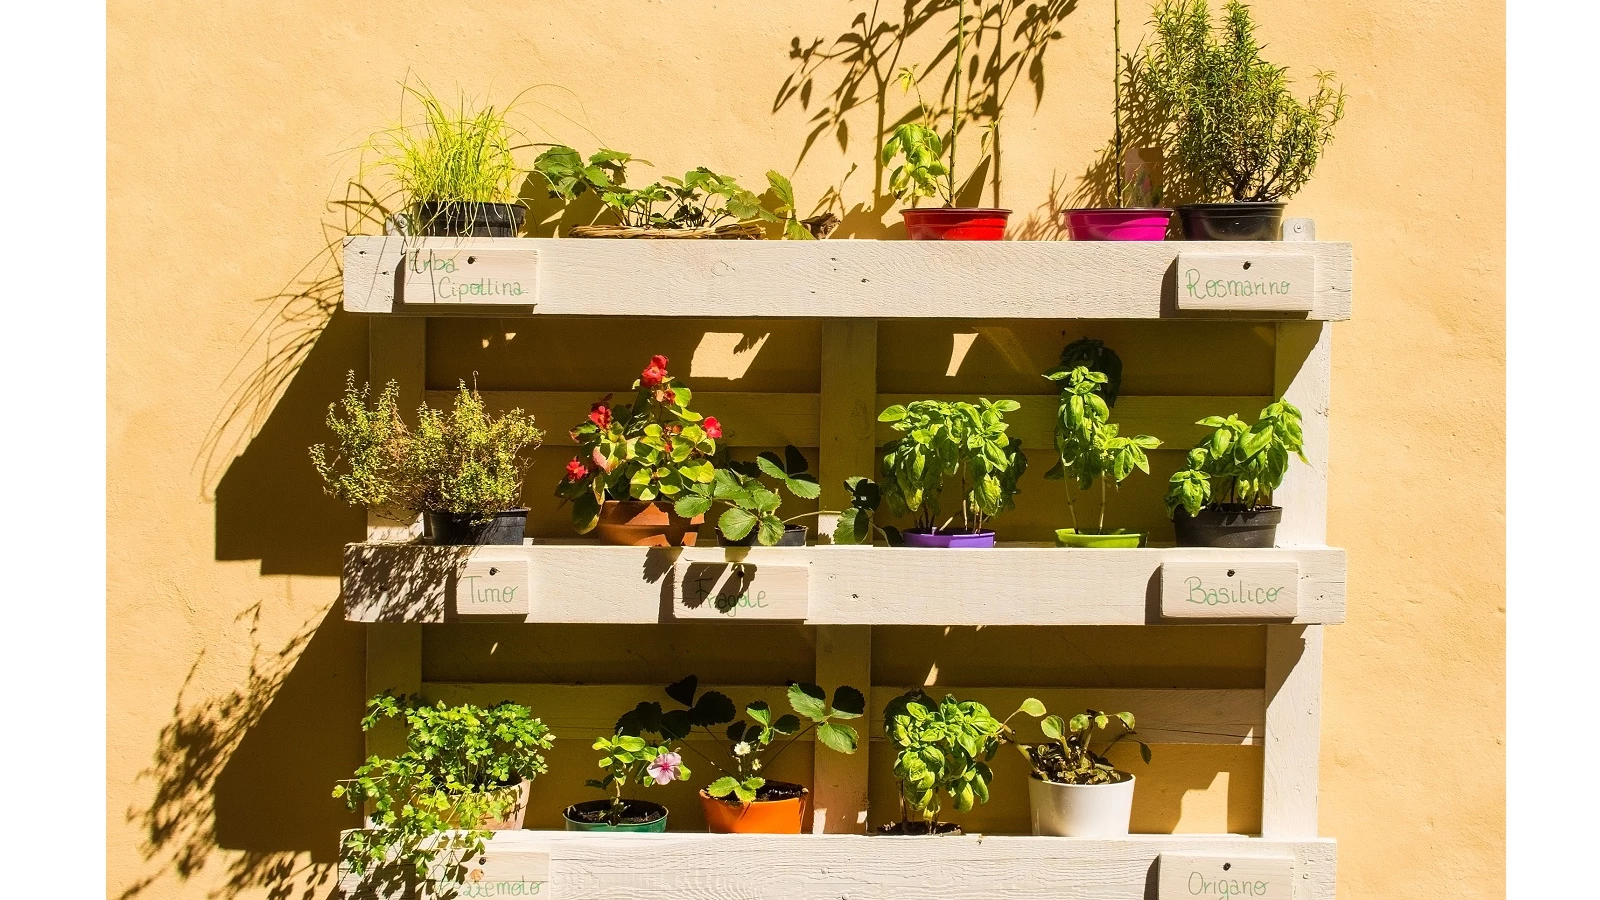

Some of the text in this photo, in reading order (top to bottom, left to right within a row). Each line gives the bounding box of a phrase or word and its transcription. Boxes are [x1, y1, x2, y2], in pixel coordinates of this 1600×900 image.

[438, 276, 529, 302] Cipollina
[1185, 268, 1290, 300] Rosmarino
[463, 575, 519, 604] Timo
[695, 577, 769, 617] Fragole
[1183, 576, 1285, 606] Basilico
[1188, 871, 1270, 900] Origano
